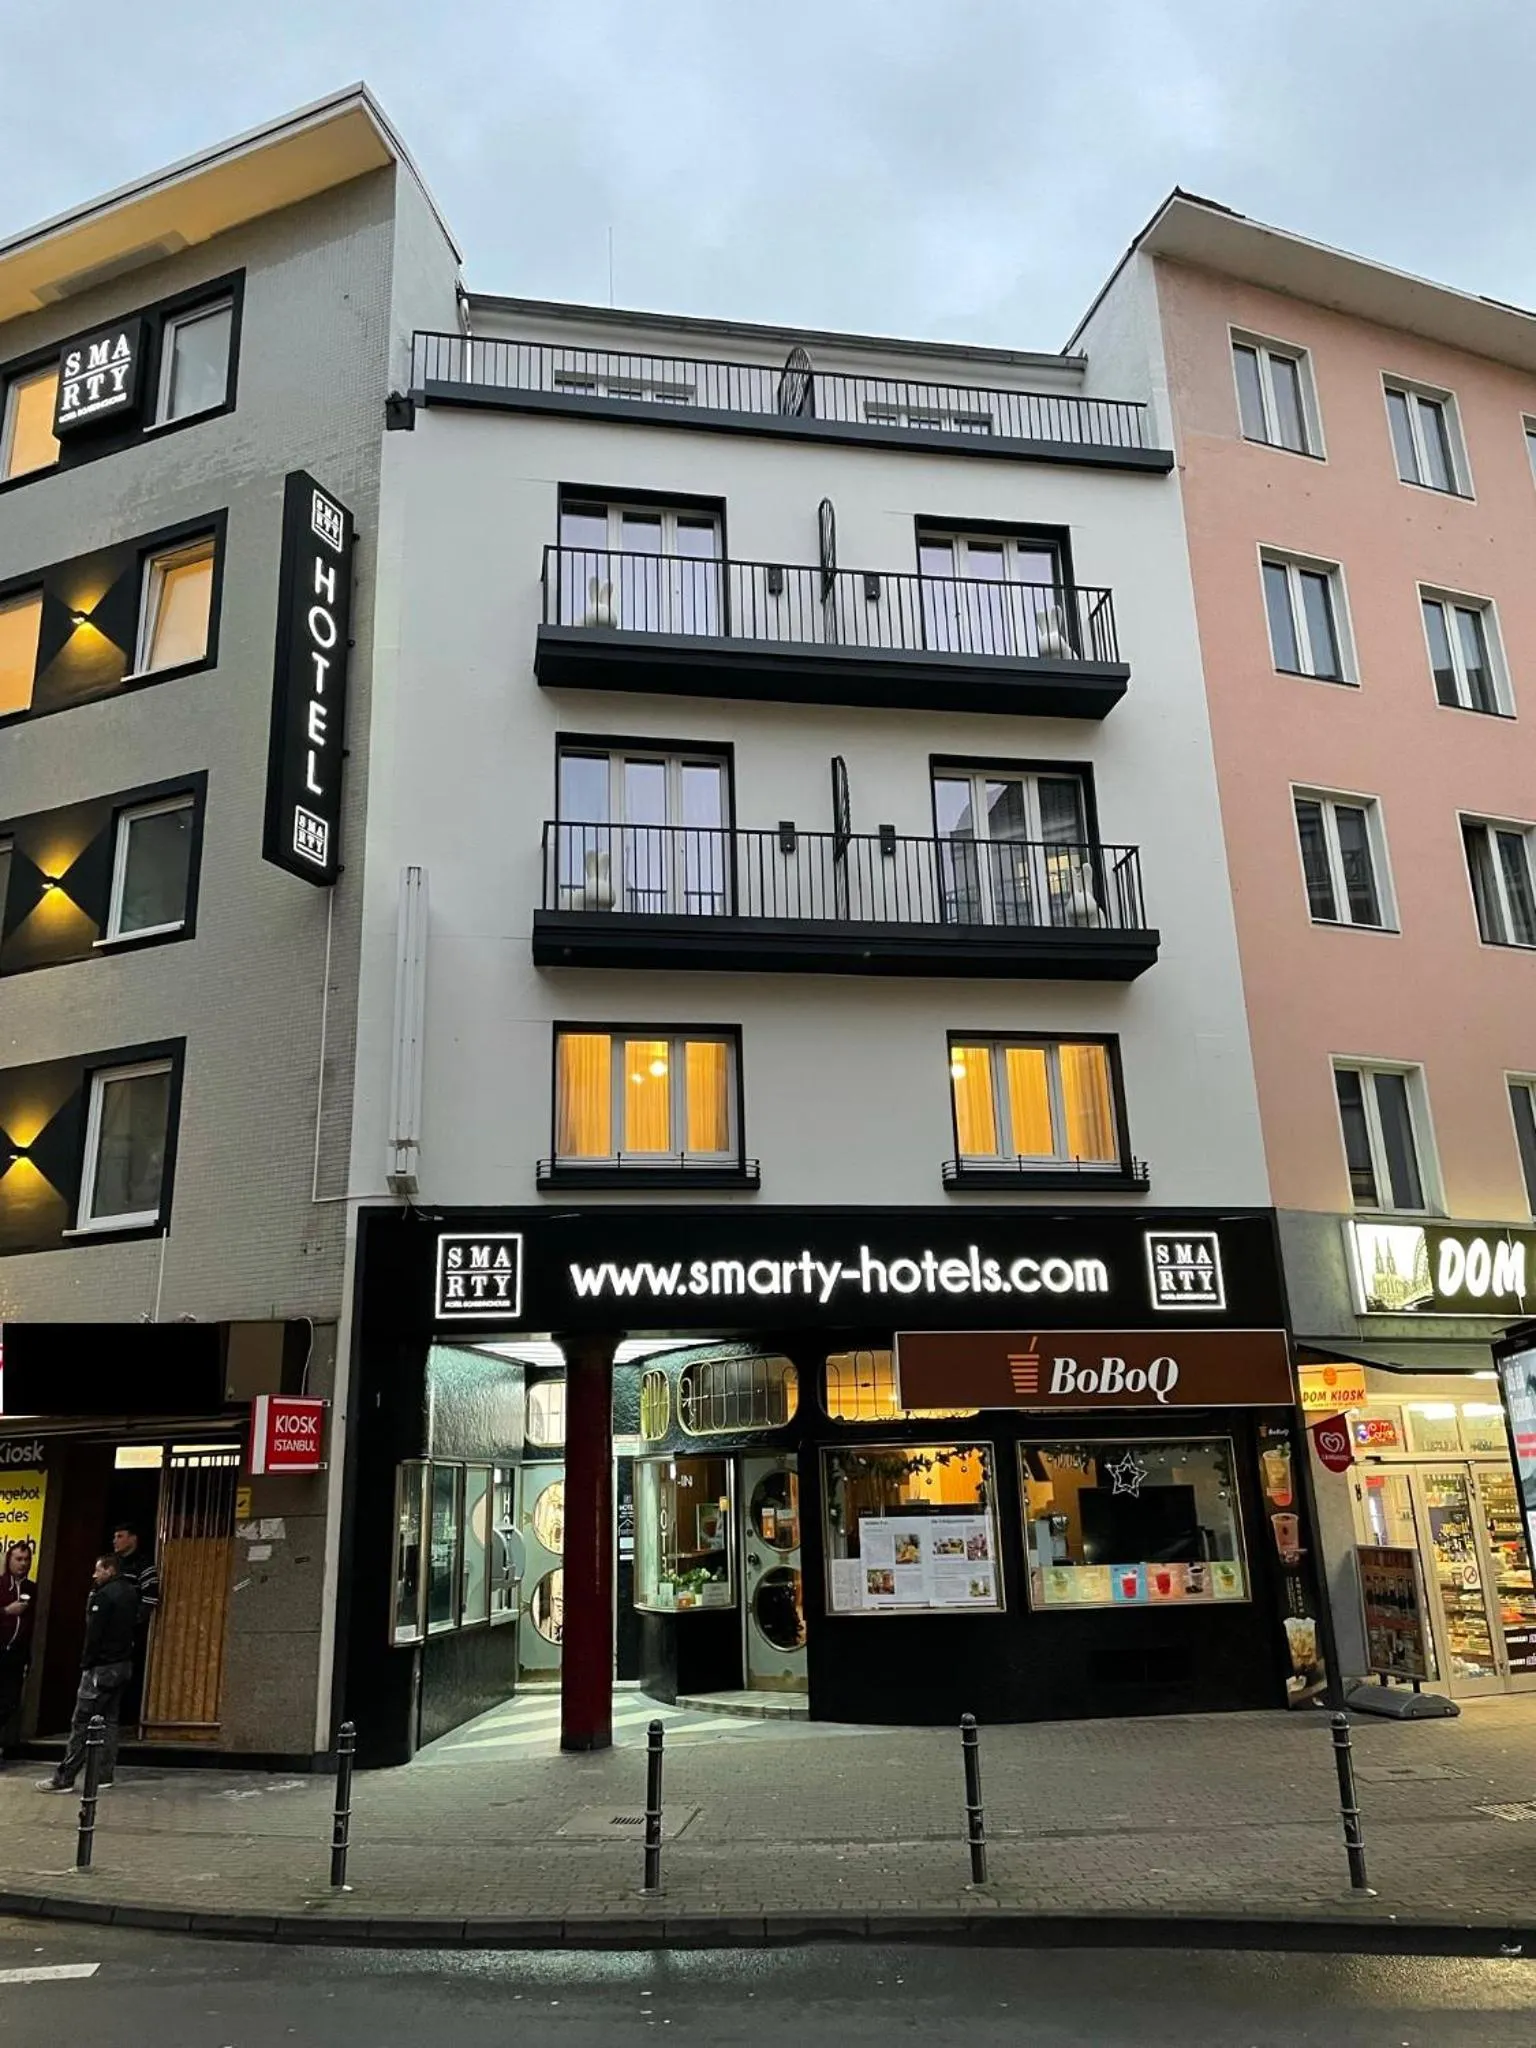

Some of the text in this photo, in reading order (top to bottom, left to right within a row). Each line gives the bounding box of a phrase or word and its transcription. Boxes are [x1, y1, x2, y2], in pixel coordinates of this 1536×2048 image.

[65, 333, 131, 378] SMA
[61, 364, 129, 411] RTY
[307, 556, 337, 796] HOTEL
[447, 1244, 512, 1269] SMA
[1156, 1242, 1213, 1265] SMA
[569, 1244, 1109, 1304] www.smarty-hotels.com
[1438, 1237, 1526, 1298] DOM
[446, 1274, 512, 1298] RTY
[1159, 1270, 1214, 1291] RTY
[1048, 1356, 1180, 1404] BoBoQ
[1303, 1388, 1365, 1403] DOM KIOSK
[275, 1415, 318, 1434] KIOSK
[274, 1439, 317, 1452] ISTANBUL
